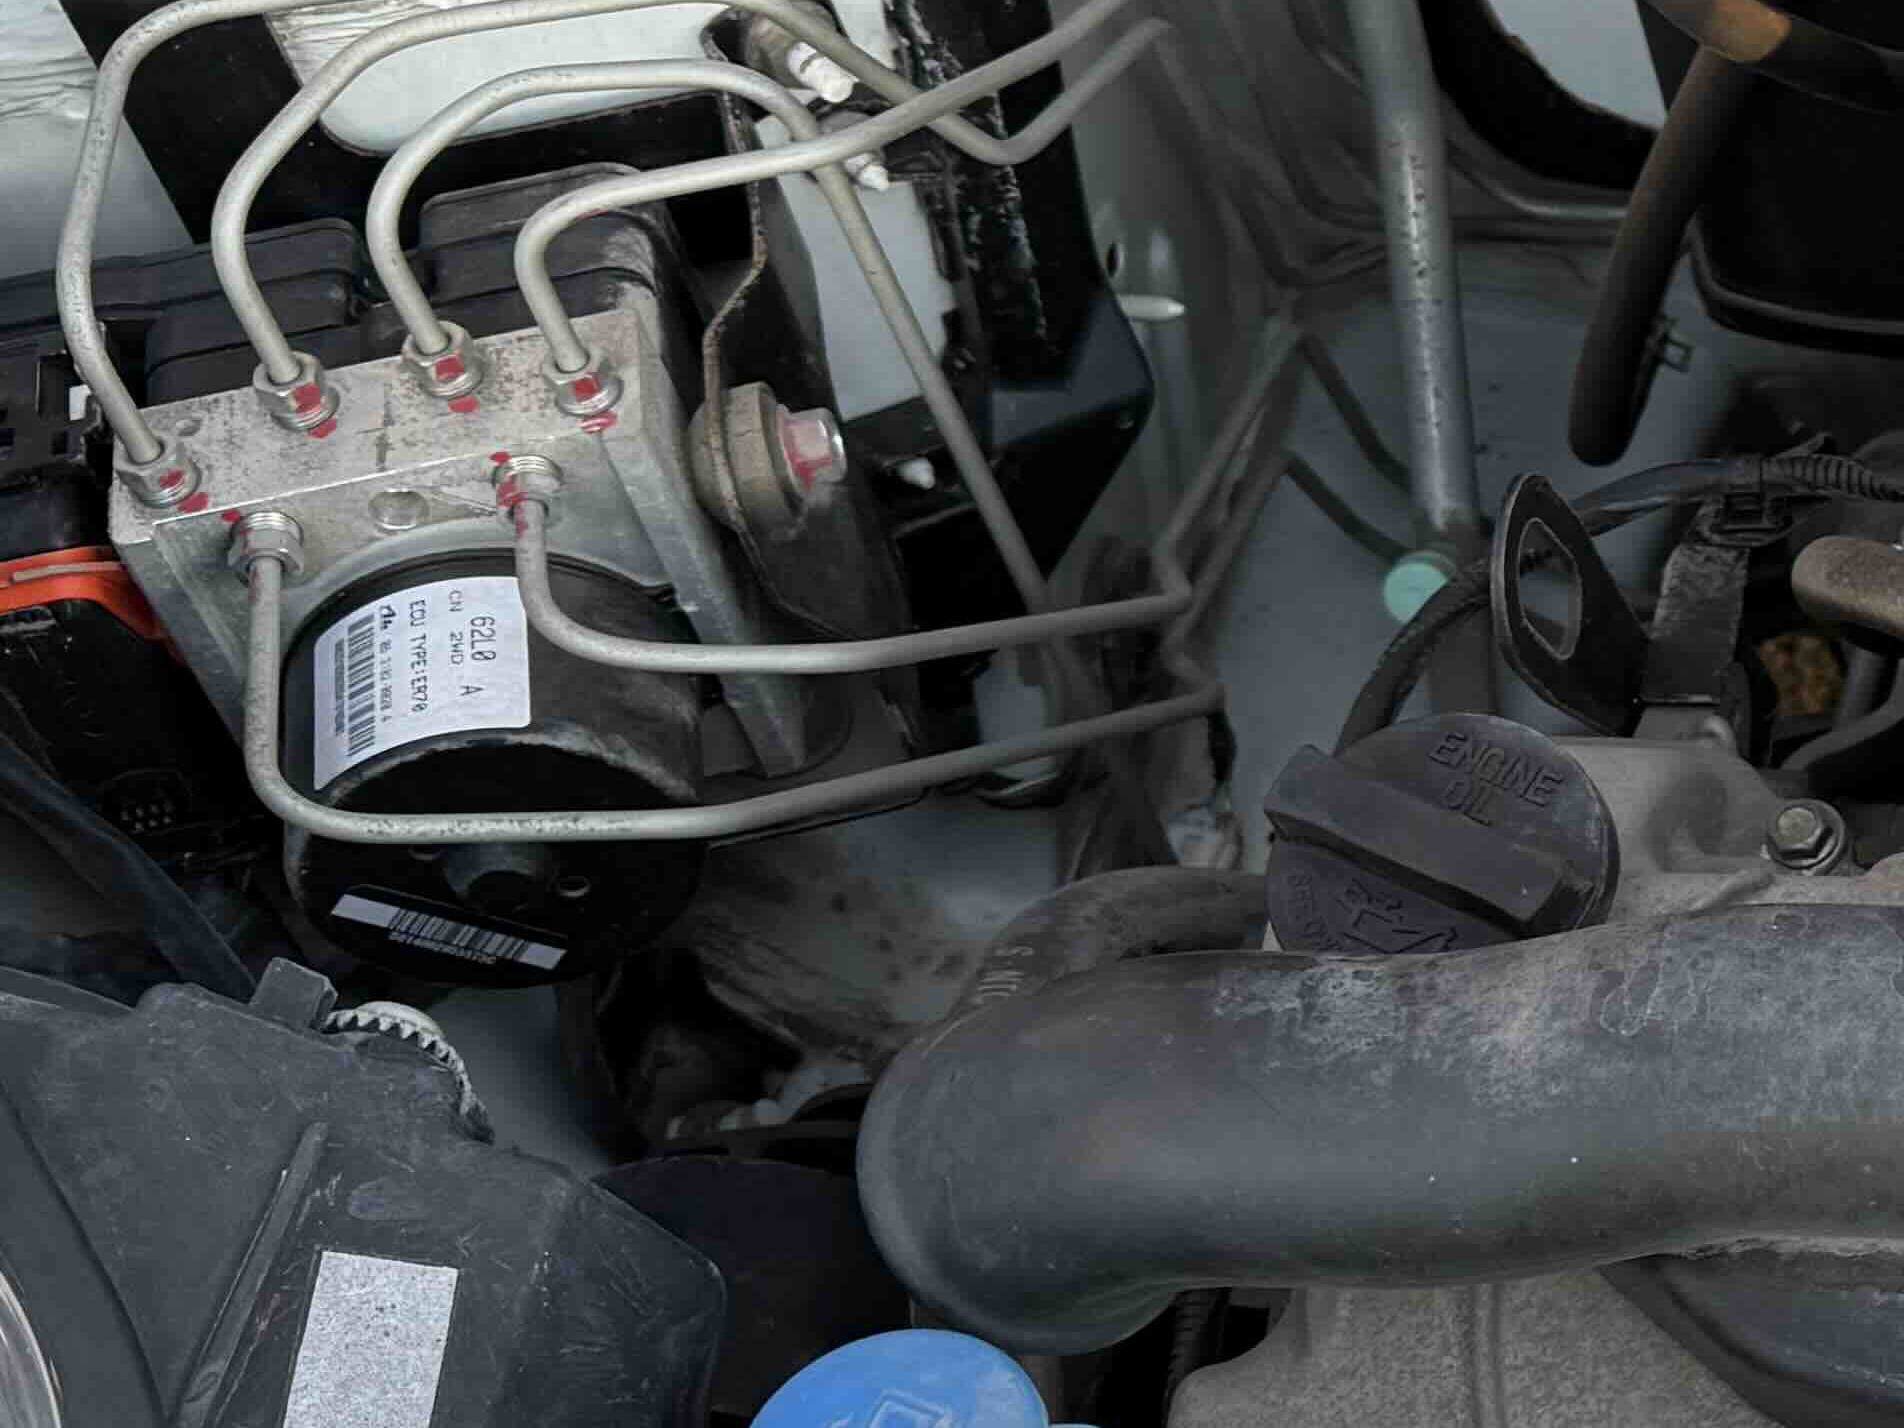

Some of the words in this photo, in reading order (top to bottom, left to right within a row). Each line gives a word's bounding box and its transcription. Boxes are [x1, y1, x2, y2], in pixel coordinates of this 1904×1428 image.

[408, 600, 427, 627] ECU
[448, 590, 464, 613] CN
[469, 616, 498, 662] 62L0
[1428, 732, 1564, 808] ENGINE
[1441, 779, 1492, 827] OIL
